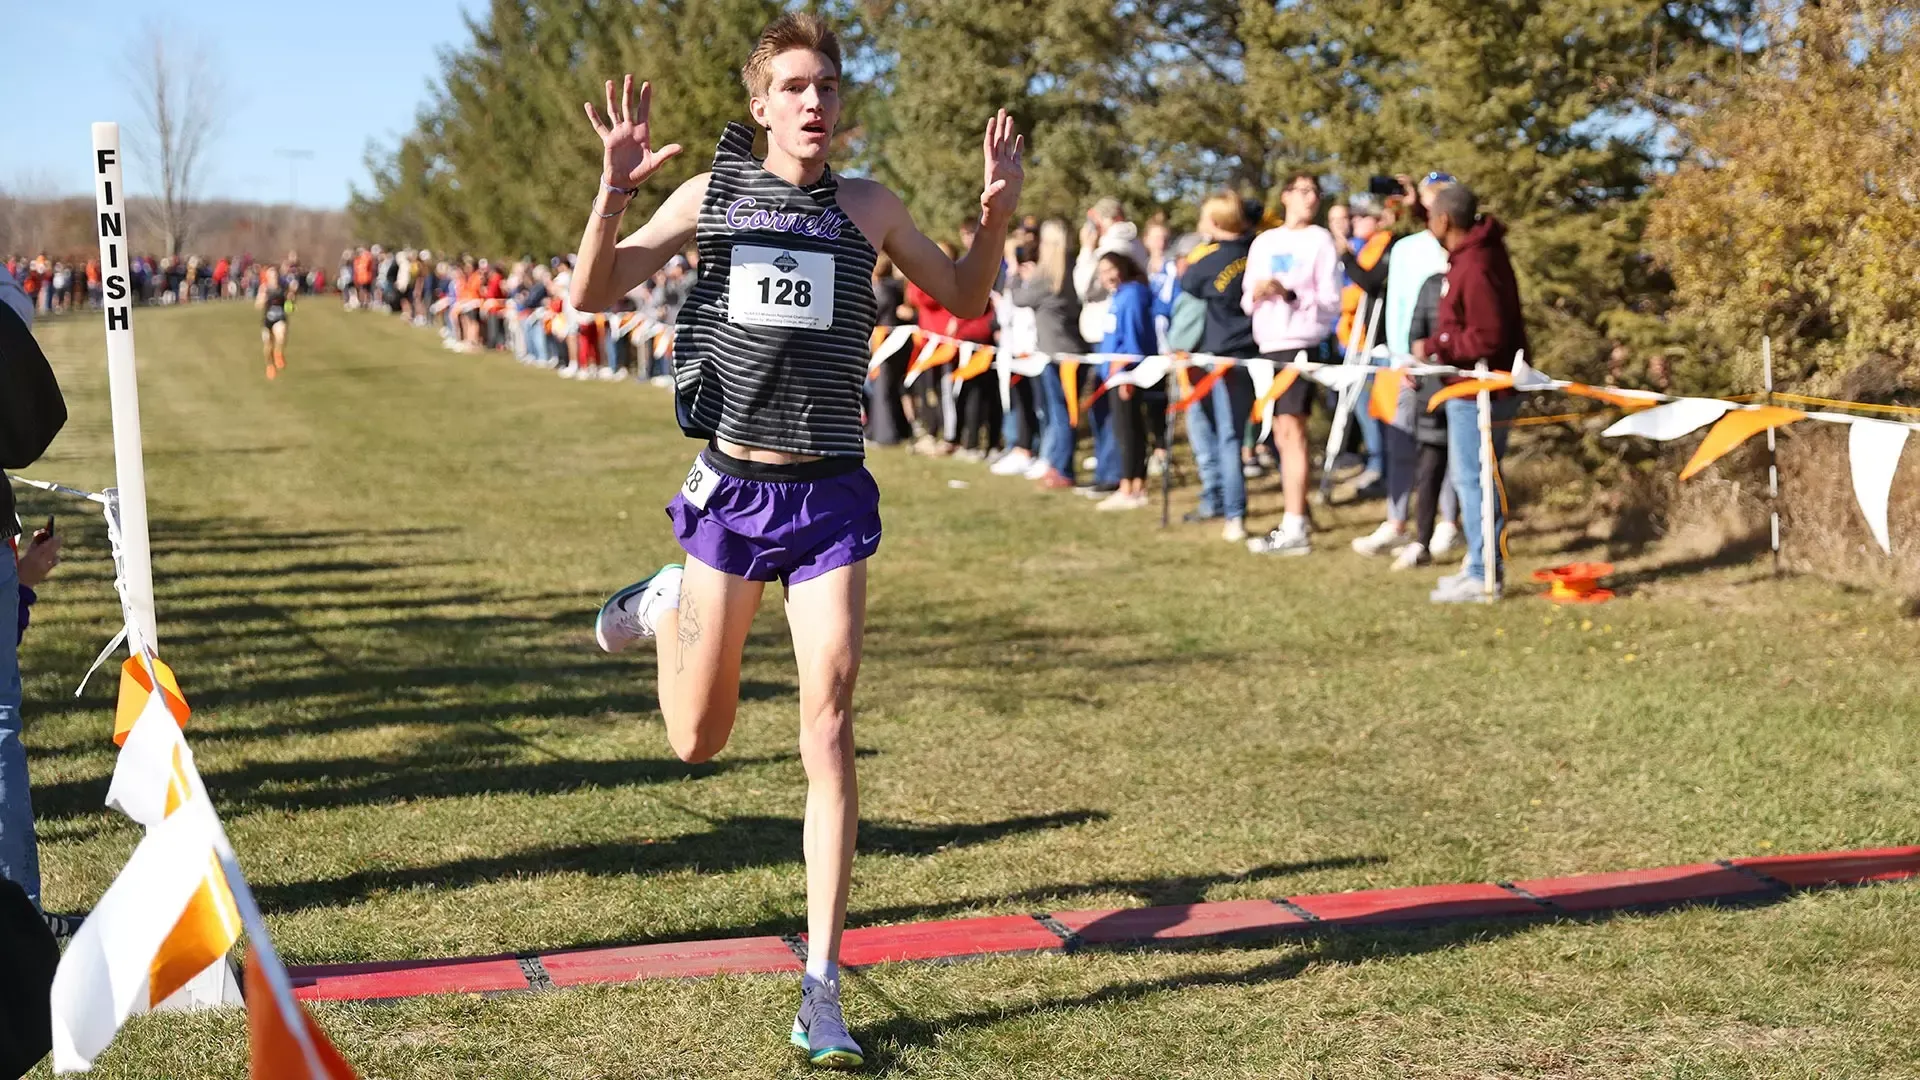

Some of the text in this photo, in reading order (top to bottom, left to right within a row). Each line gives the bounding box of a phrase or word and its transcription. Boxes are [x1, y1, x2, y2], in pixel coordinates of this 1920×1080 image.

[97, 150, 129, 330] FINISH
[726, 196, 843, 240] Cornell
[757, 277, 812, 307] 128
